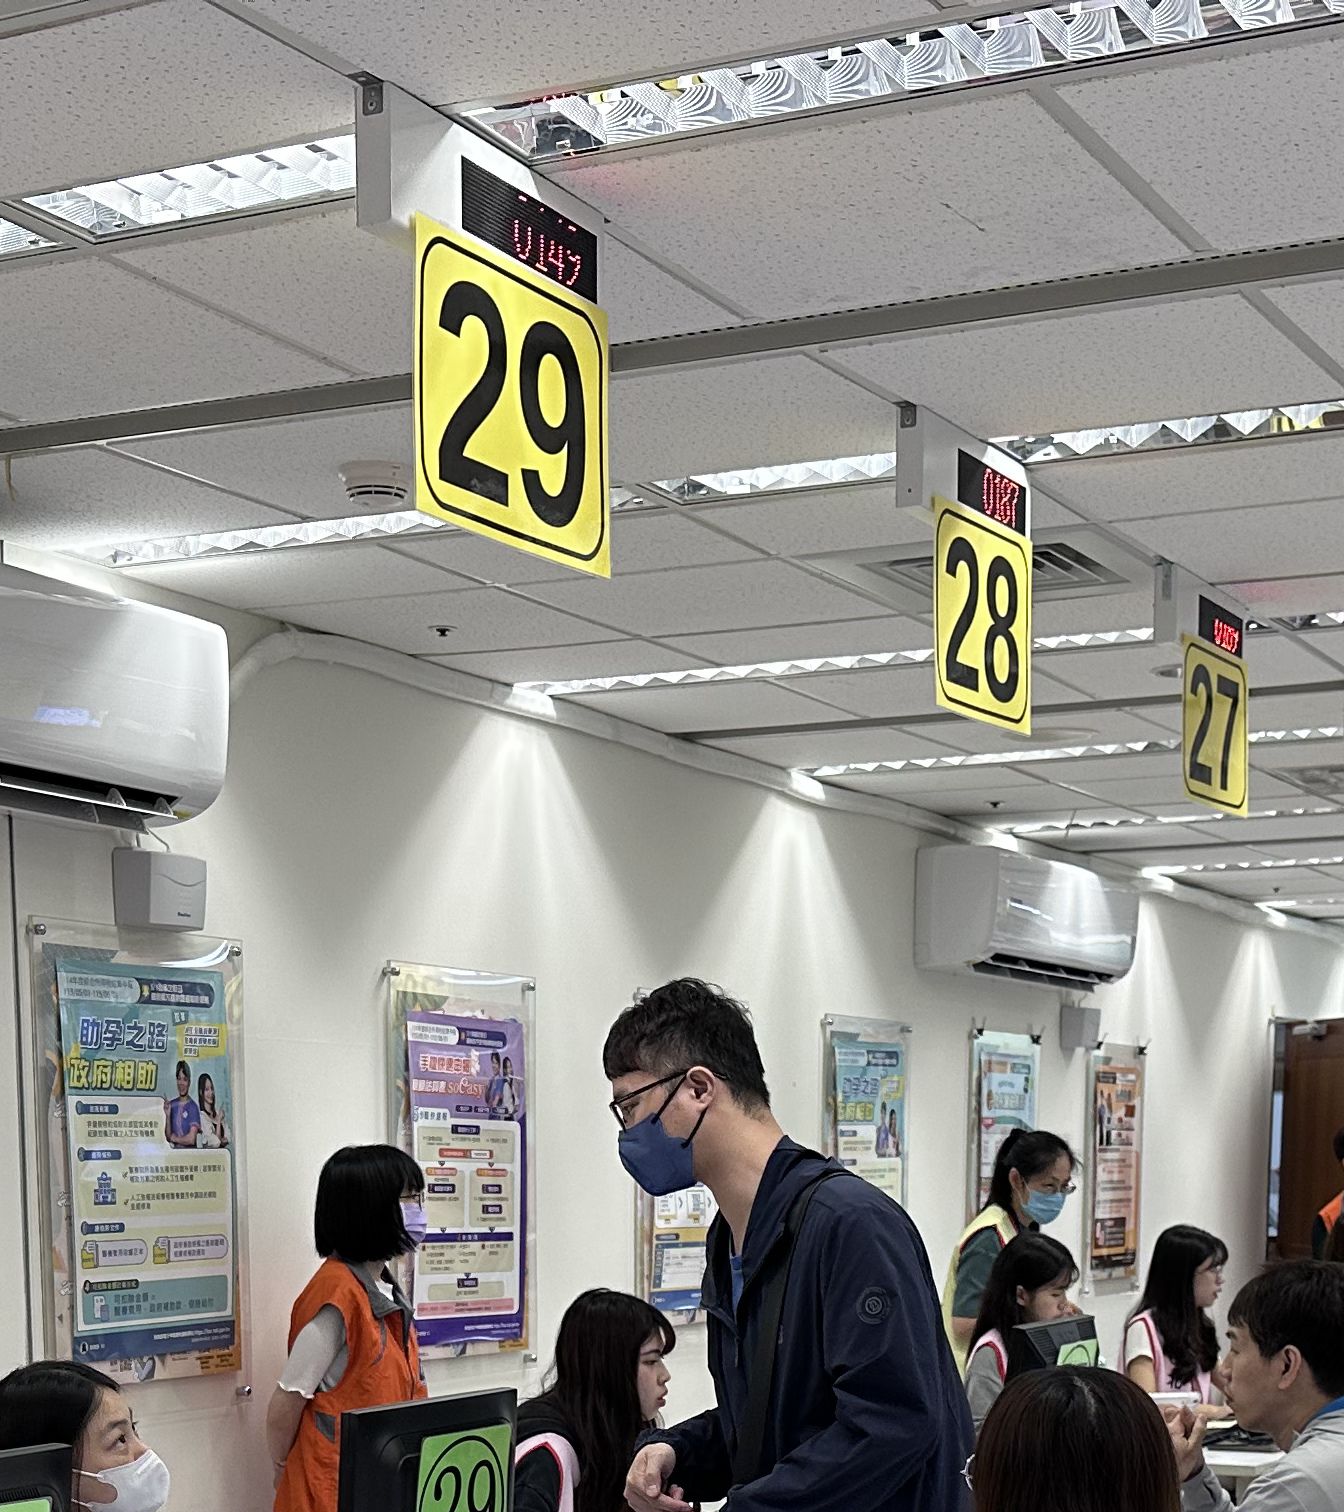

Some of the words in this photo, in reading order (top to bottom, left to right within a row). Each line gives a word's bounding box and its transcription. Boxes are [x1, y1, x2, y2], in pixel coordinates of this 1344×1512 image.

[439, 281, 585, 528] 29
[946, 537, 1018, 703] 28
[1189, 664, 1239, 791] 27
[68, 1057, 158, 1092] 政府相助
[79, 1016, 169, 1053] 助孕之路
